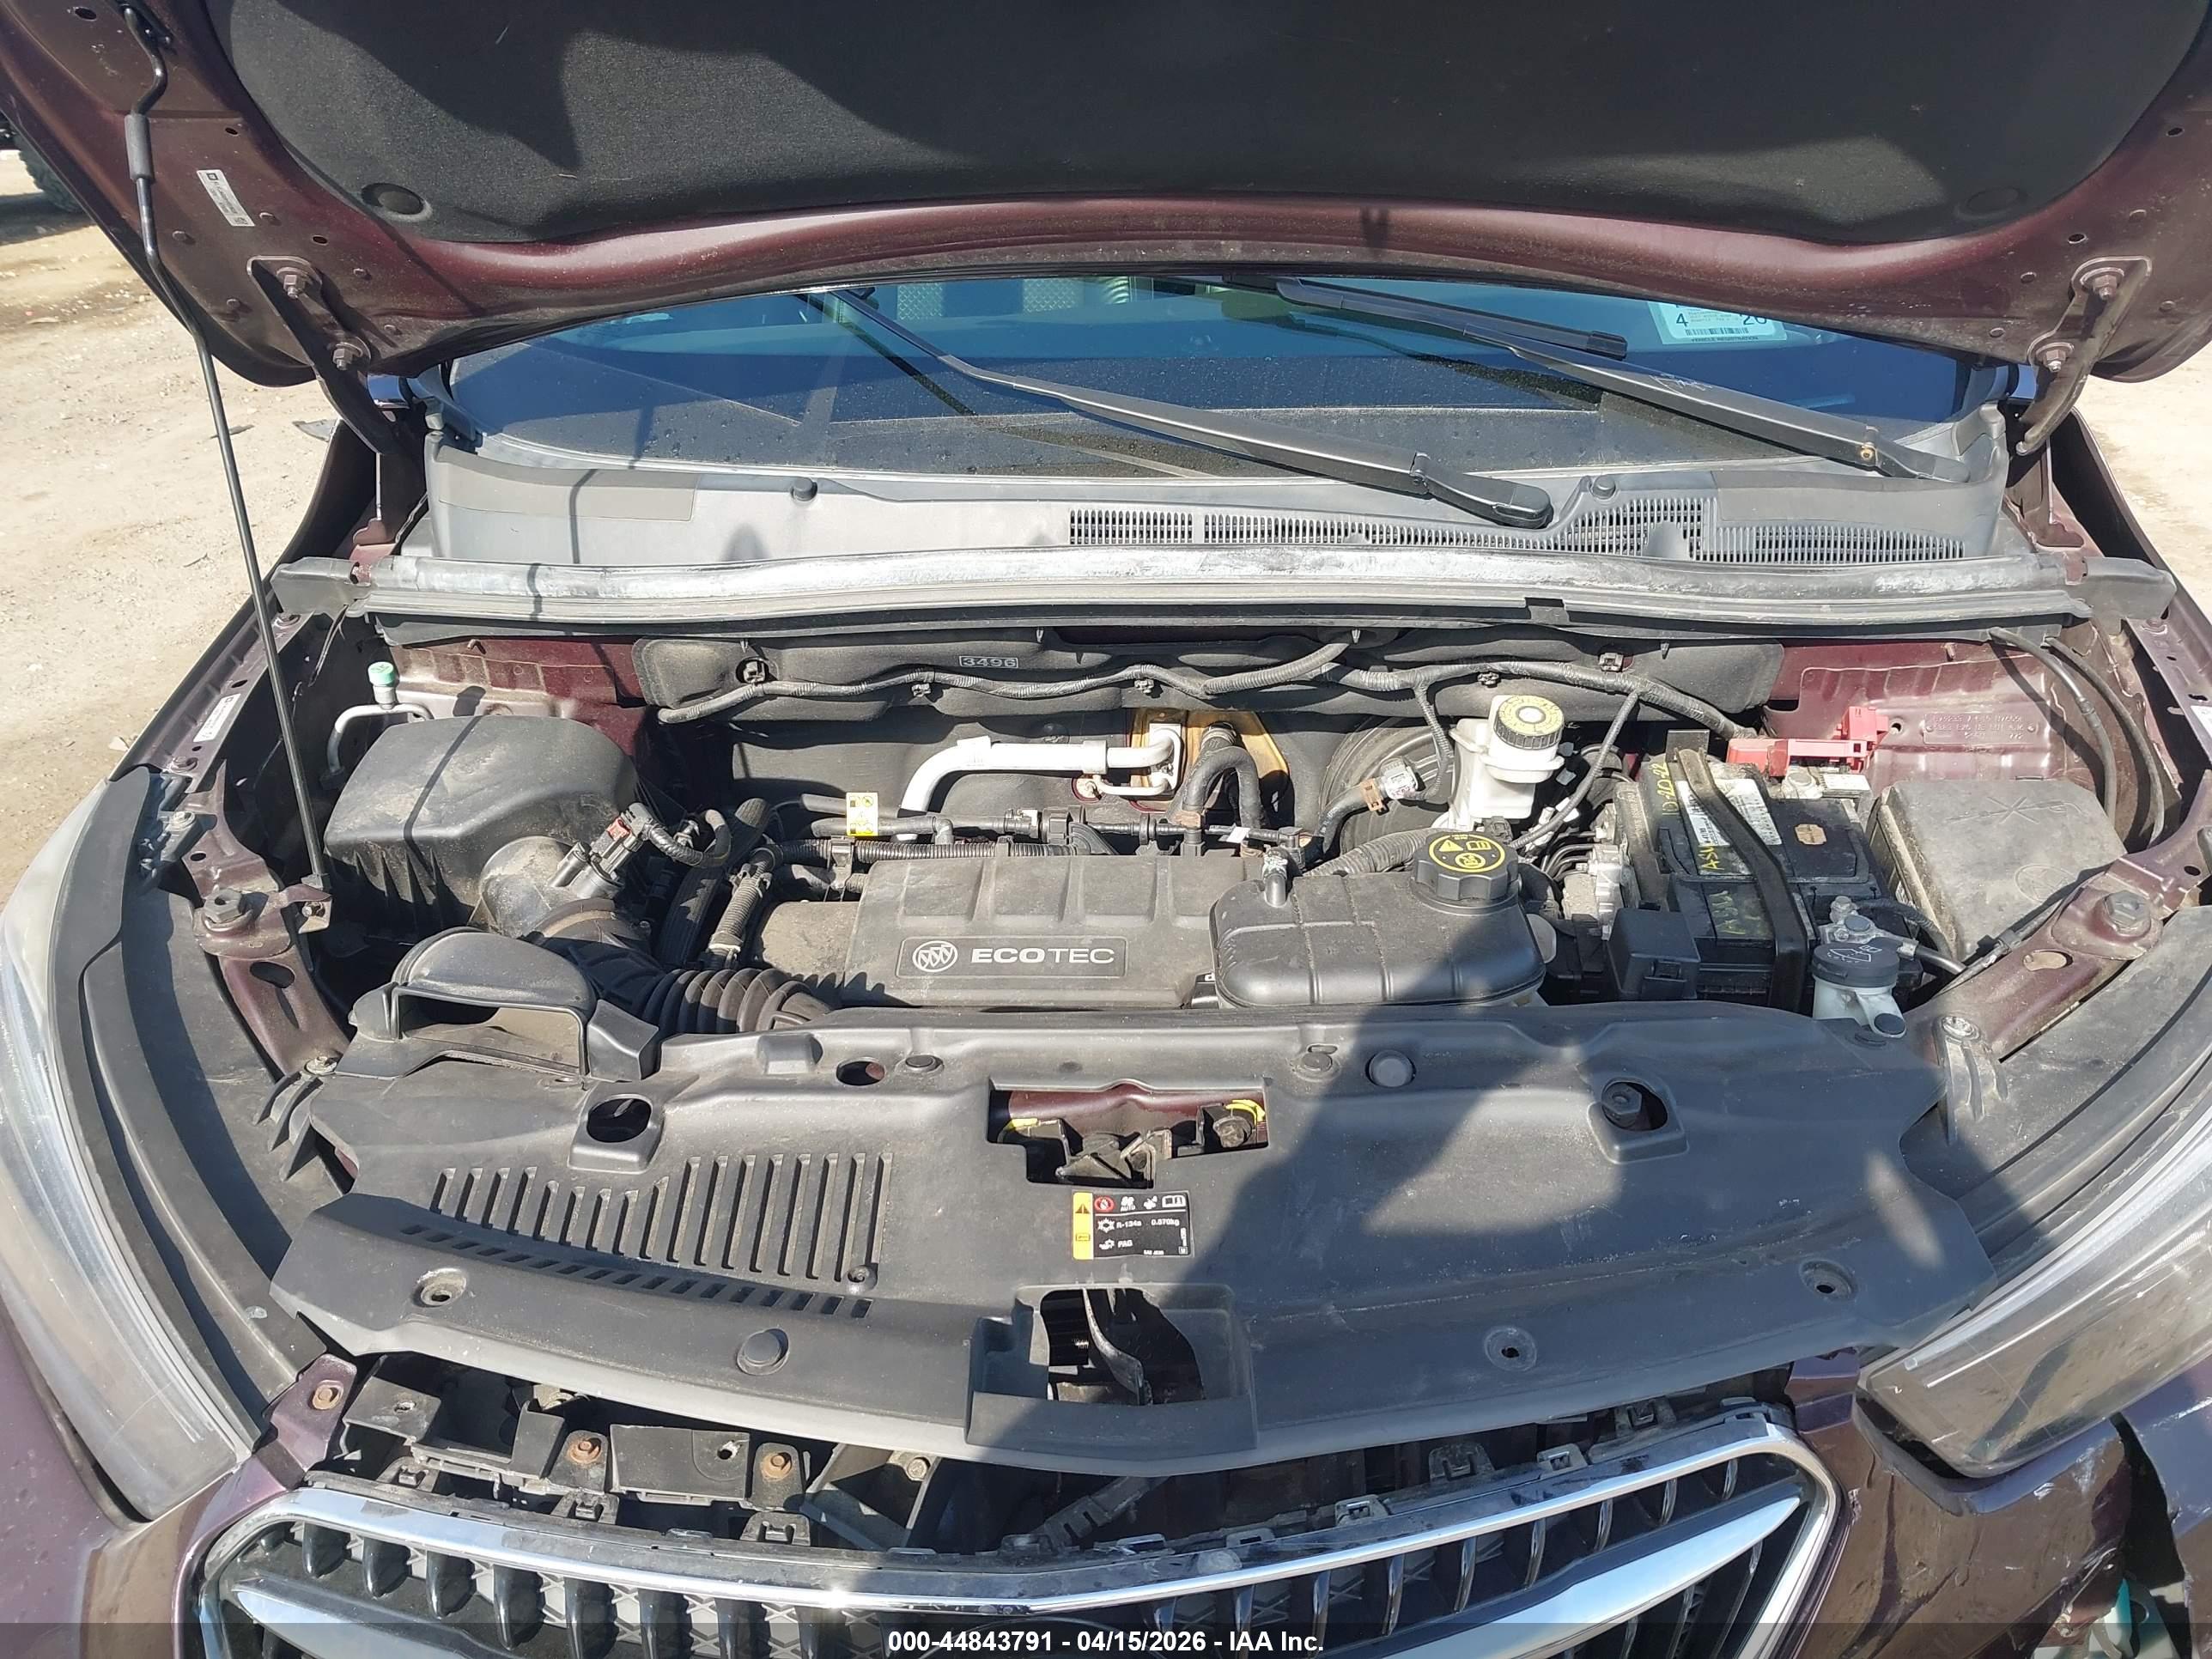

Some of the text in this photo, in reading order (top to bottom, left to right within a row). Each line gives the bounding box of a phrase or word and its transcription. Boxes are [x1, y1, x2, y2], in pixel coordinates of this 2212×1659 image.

[1675, 313, 1689, 327] 4
[963, 657, 1016, 667] 3496
[970, 947, 1115, 963] ECOTEC
[1116, 1220, 1142, 1229] R-134a
[1117, 1239, 1133, 1249] PAG
